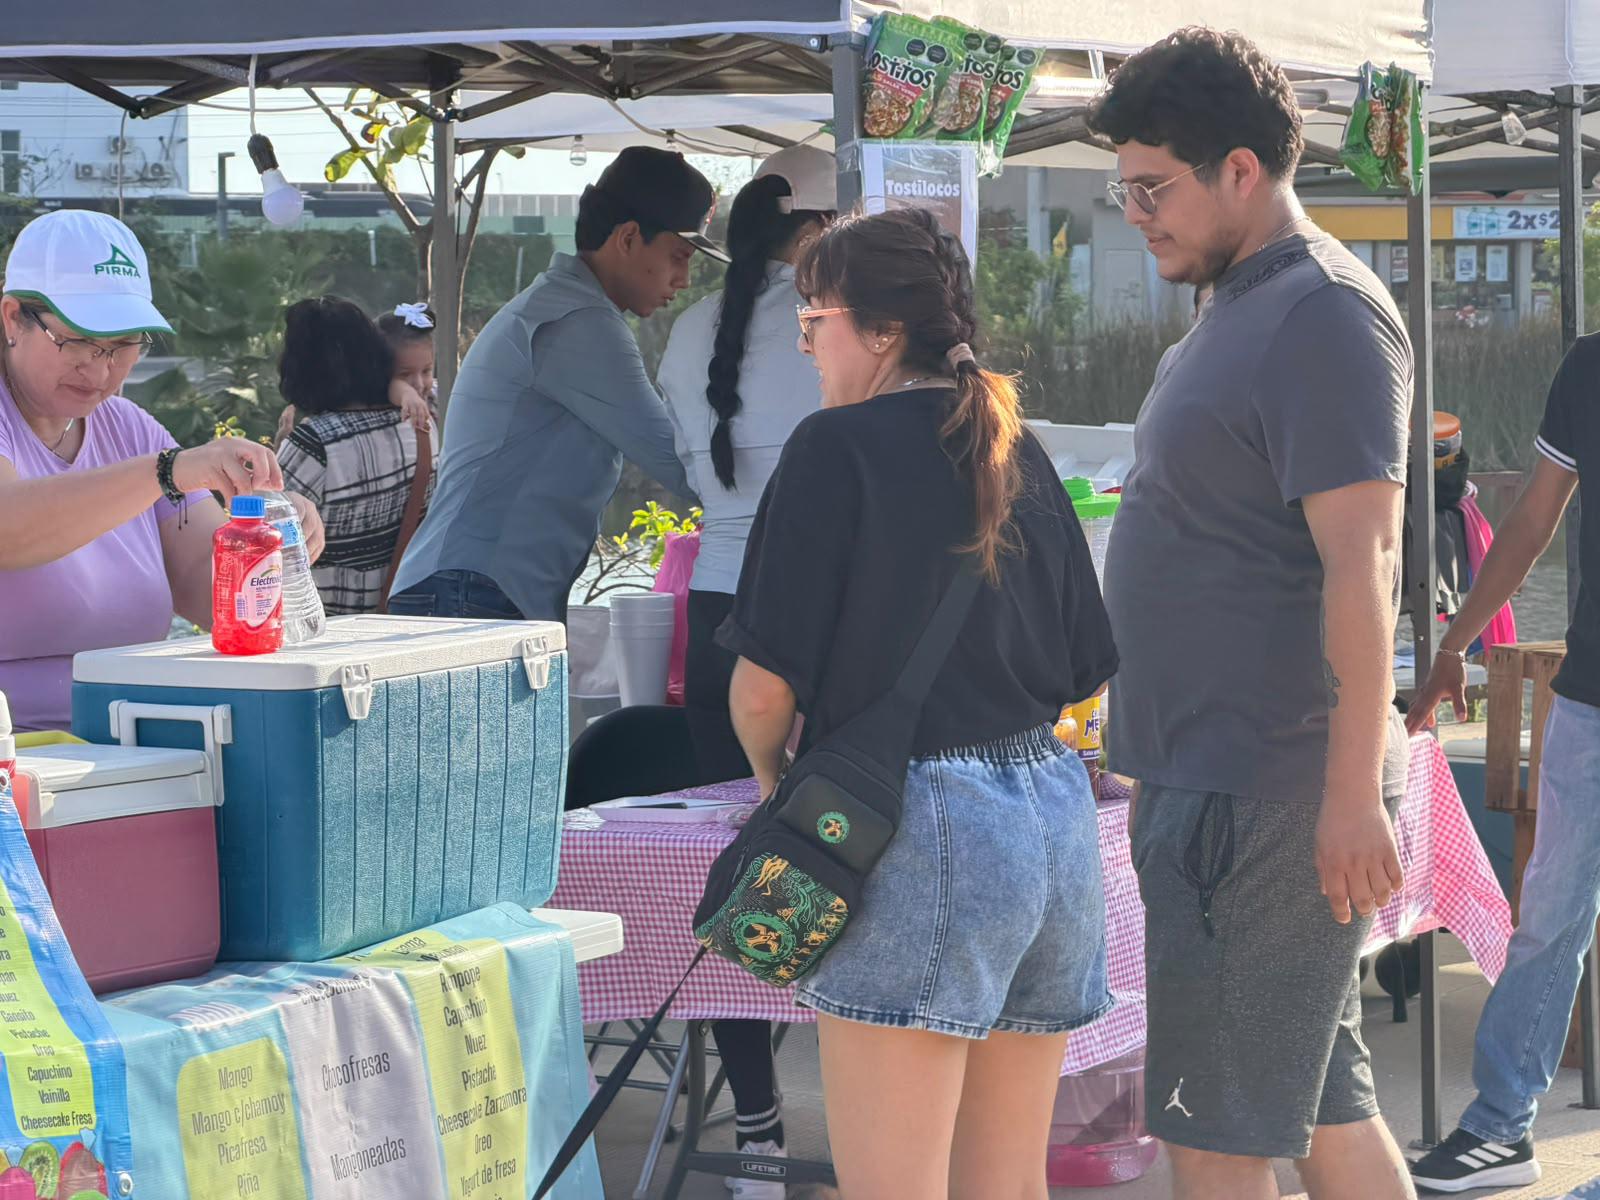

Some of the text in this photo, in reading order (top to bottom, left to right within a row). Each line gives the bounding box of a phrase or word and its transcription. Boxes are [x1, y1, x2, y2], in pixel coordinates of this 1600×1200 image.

[871, 52, 935, 88] ostitos
[885, 179, 960, 197] Tostilocos
[1507, 209, 1561, 231] 2x$2
[94, 264, 141, 278] PIRMA
[33, 1044, 55, 1057] Oreo
[464, 1034, 487, 1055] Nuez
[27, 1064, 73, 1083] Capuchino
[218, 1065, 253, 1091] Mango
[321, 1052, 391, 1091] Chocofresas
[461, 1062, 497, 1092] Pistache
[38, 1088, 71, 1105] Vainilla
[20, 1111, 93, 1131] Cheesecake Fresa
[192, 1092, 286, 1136] Mango c/chamoy
[437, 1087, 527, 1136] Cheesecake Zarzamora
[218, 1135, 267, 1166] Picafresa
[474, 1134, 492, 1155] Oreo
[330, 1136, 407, 1181] Mangoneadas
[747, 1163, 781, 1174] LIFETIME
[482, 1164, 492, 1185] de
[495, 1158, 516, 1179] fresa
[237, 1172, 260, 1197] Piña
